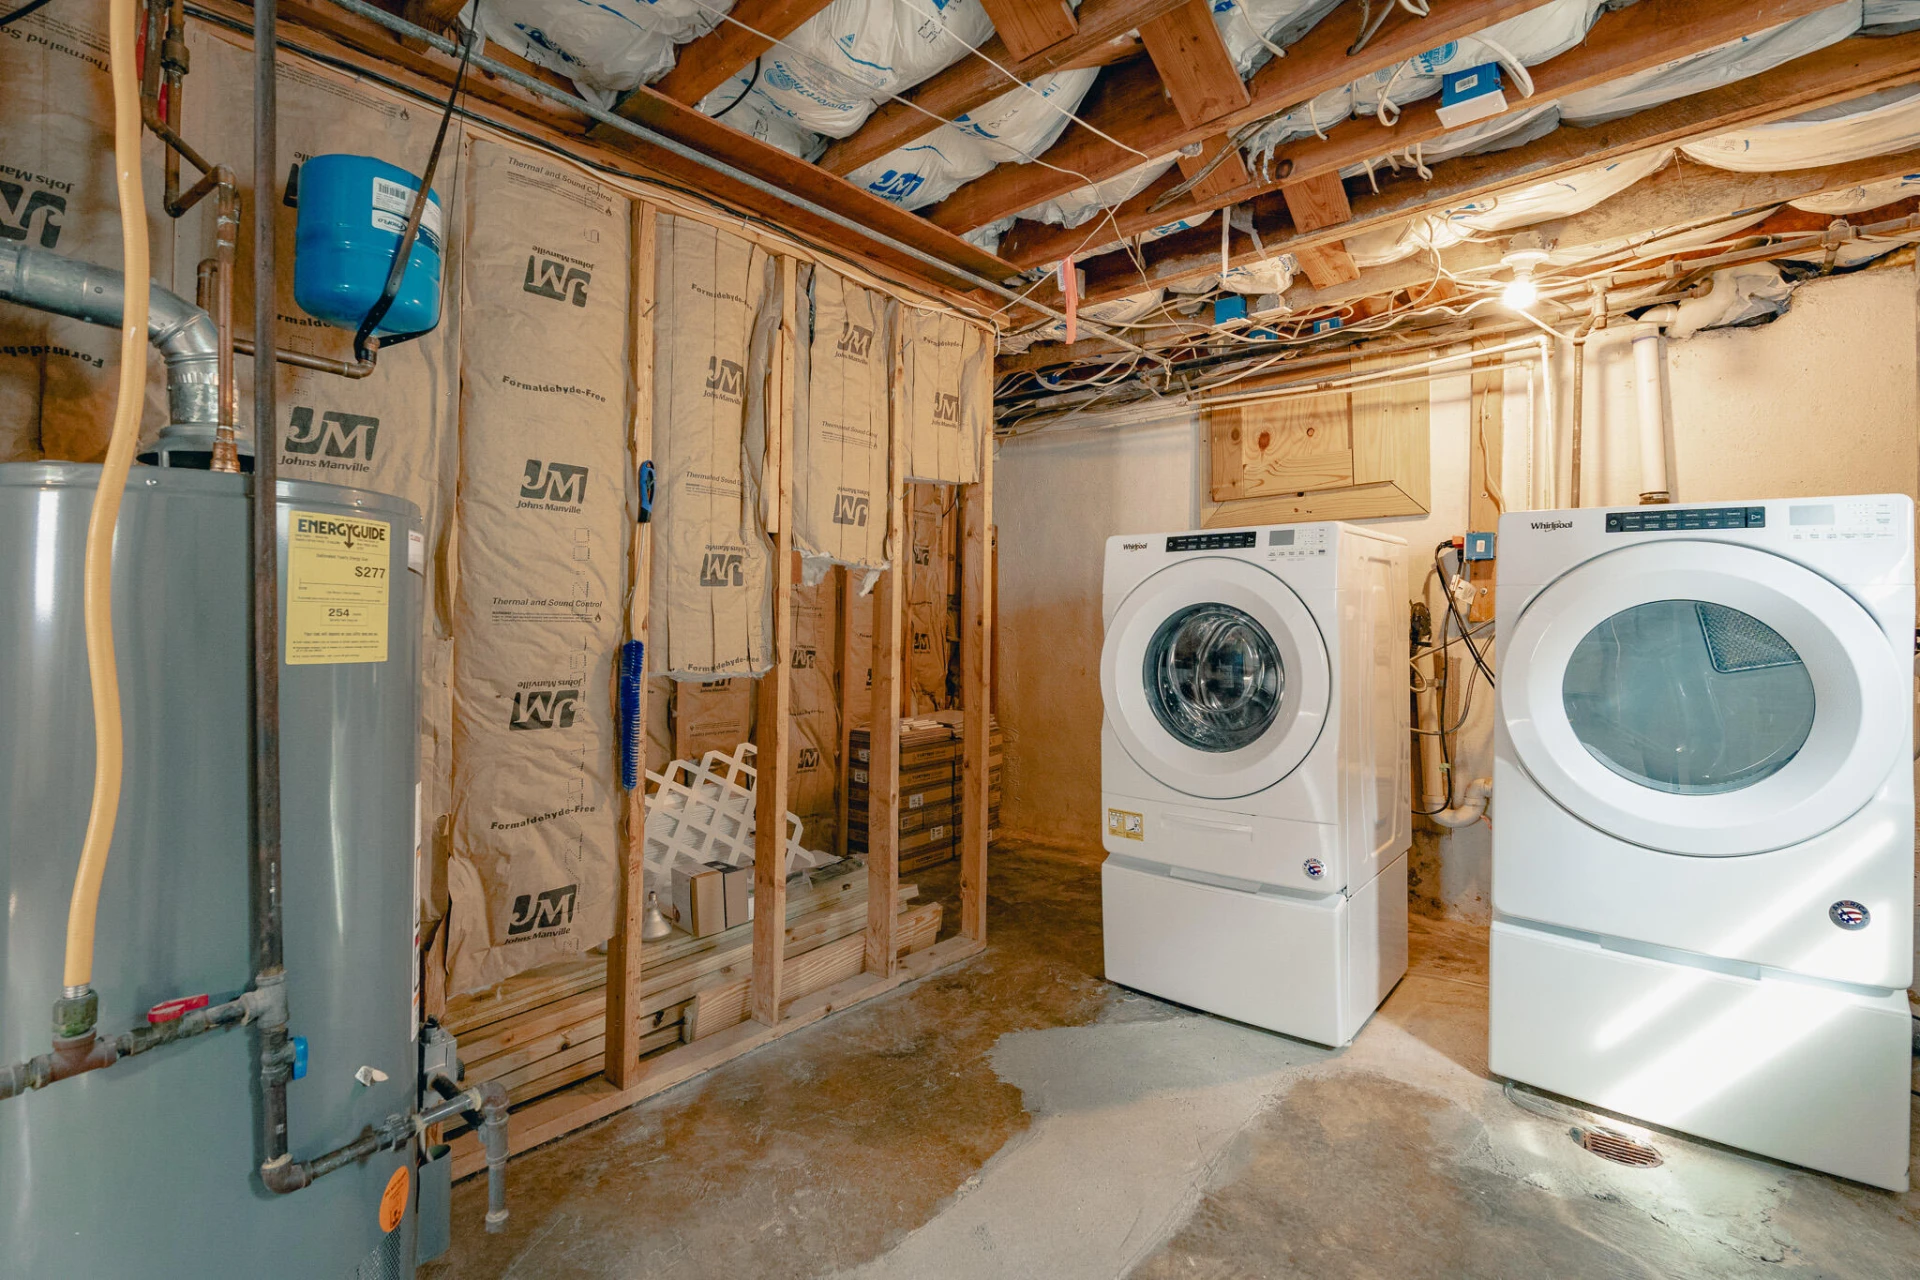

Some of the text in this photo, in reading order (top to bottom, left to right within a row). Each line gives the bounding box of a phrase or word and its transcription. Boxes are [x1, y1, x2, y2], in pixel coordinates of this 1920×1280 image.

[508, 156, 613, 202] Thermal and Sound Control
[532, 245, 595, 271] Johns Manville
[523, 254, 592, 308] JM
[837, 321, 872, 358] JM
[502, 374, 606, 403] Formaldehyde-Free
[705, 355, 747, 398] JM
[934, 391, 960, 422] JM
[284, 405, 381, 462] JM
[277, 455, 371, 473] Johns Manville
[520, 458, 589, 505] JM
[516, 500, 582, 515] Johns Manville
[833, 493, 870, 527] JM
[1531, 520, 1573, 533] Whirlpool
[1123, 542, 1149, 553] Whirlpool
[700, 553, 744, 587] JM
[328, 607, 351, 618] 254
[492, 597, 603, 609] Thermal and Sound Control
[517, 678, 584, 691] Johns Manville
[509, 689, 580, 731] JM
[490, 805, 596, 831] Formaldehyde-Free
[508, 883, 578, 936] JM
[504, 927, 571, 947] Johns Manville
